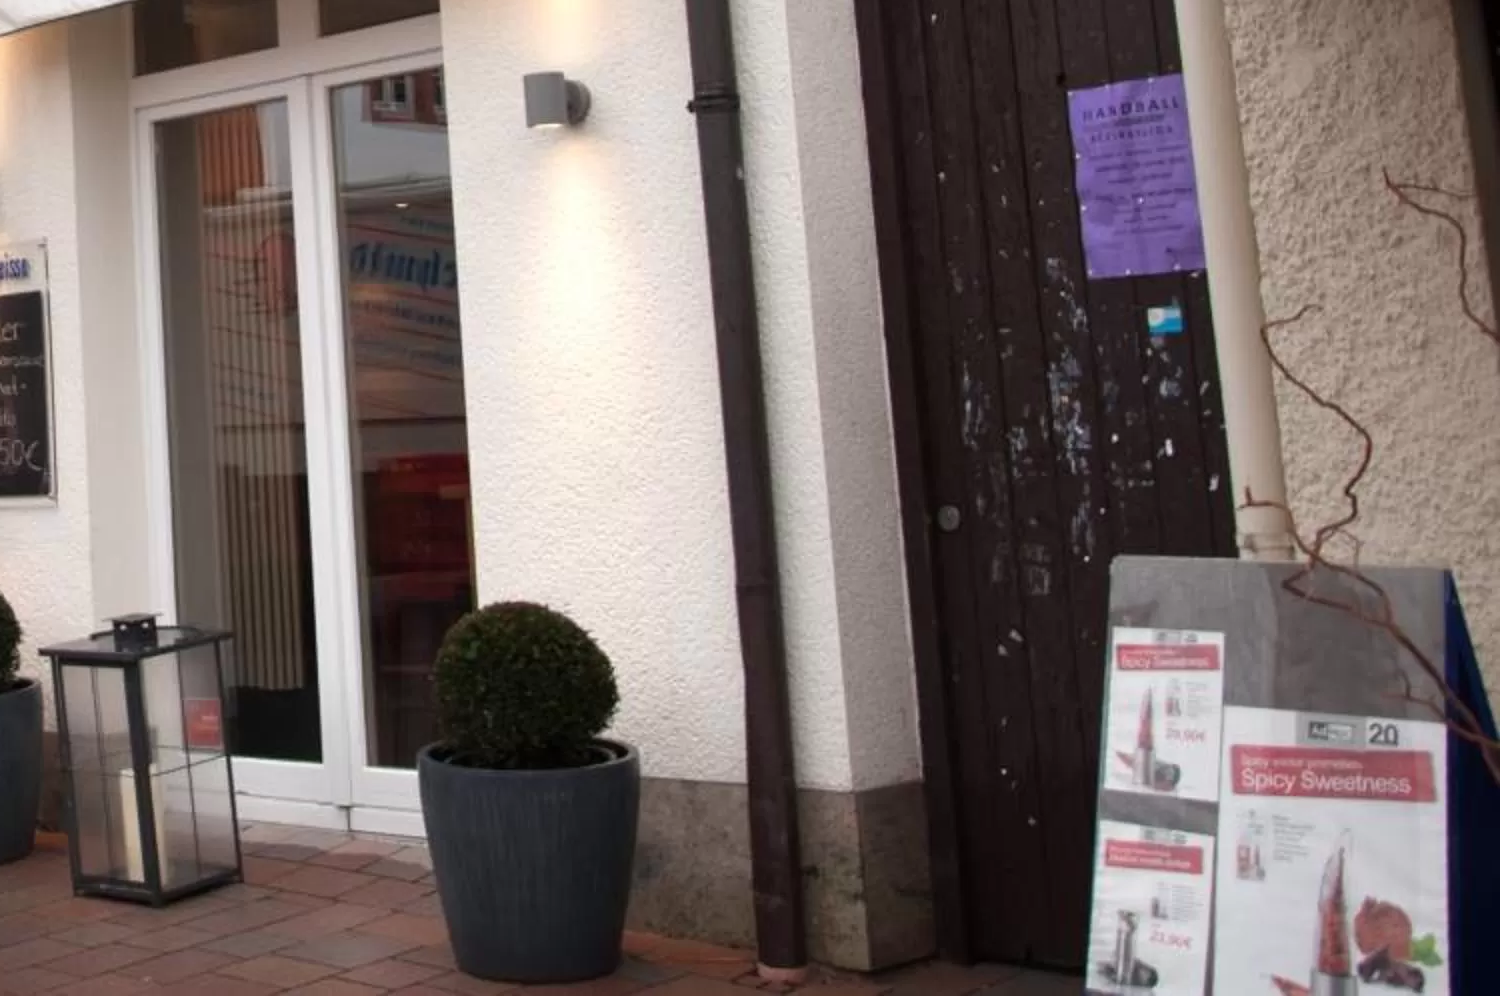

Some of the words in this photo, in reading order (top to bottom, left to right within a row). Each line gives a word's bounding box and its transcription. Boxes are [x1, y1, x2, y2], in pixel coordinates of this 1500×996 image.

[1369, 723, 1399, 746] 20
[1241, 767, 1297, 794] Spicy
[1301, 770, 1412, 795] Sweetness
